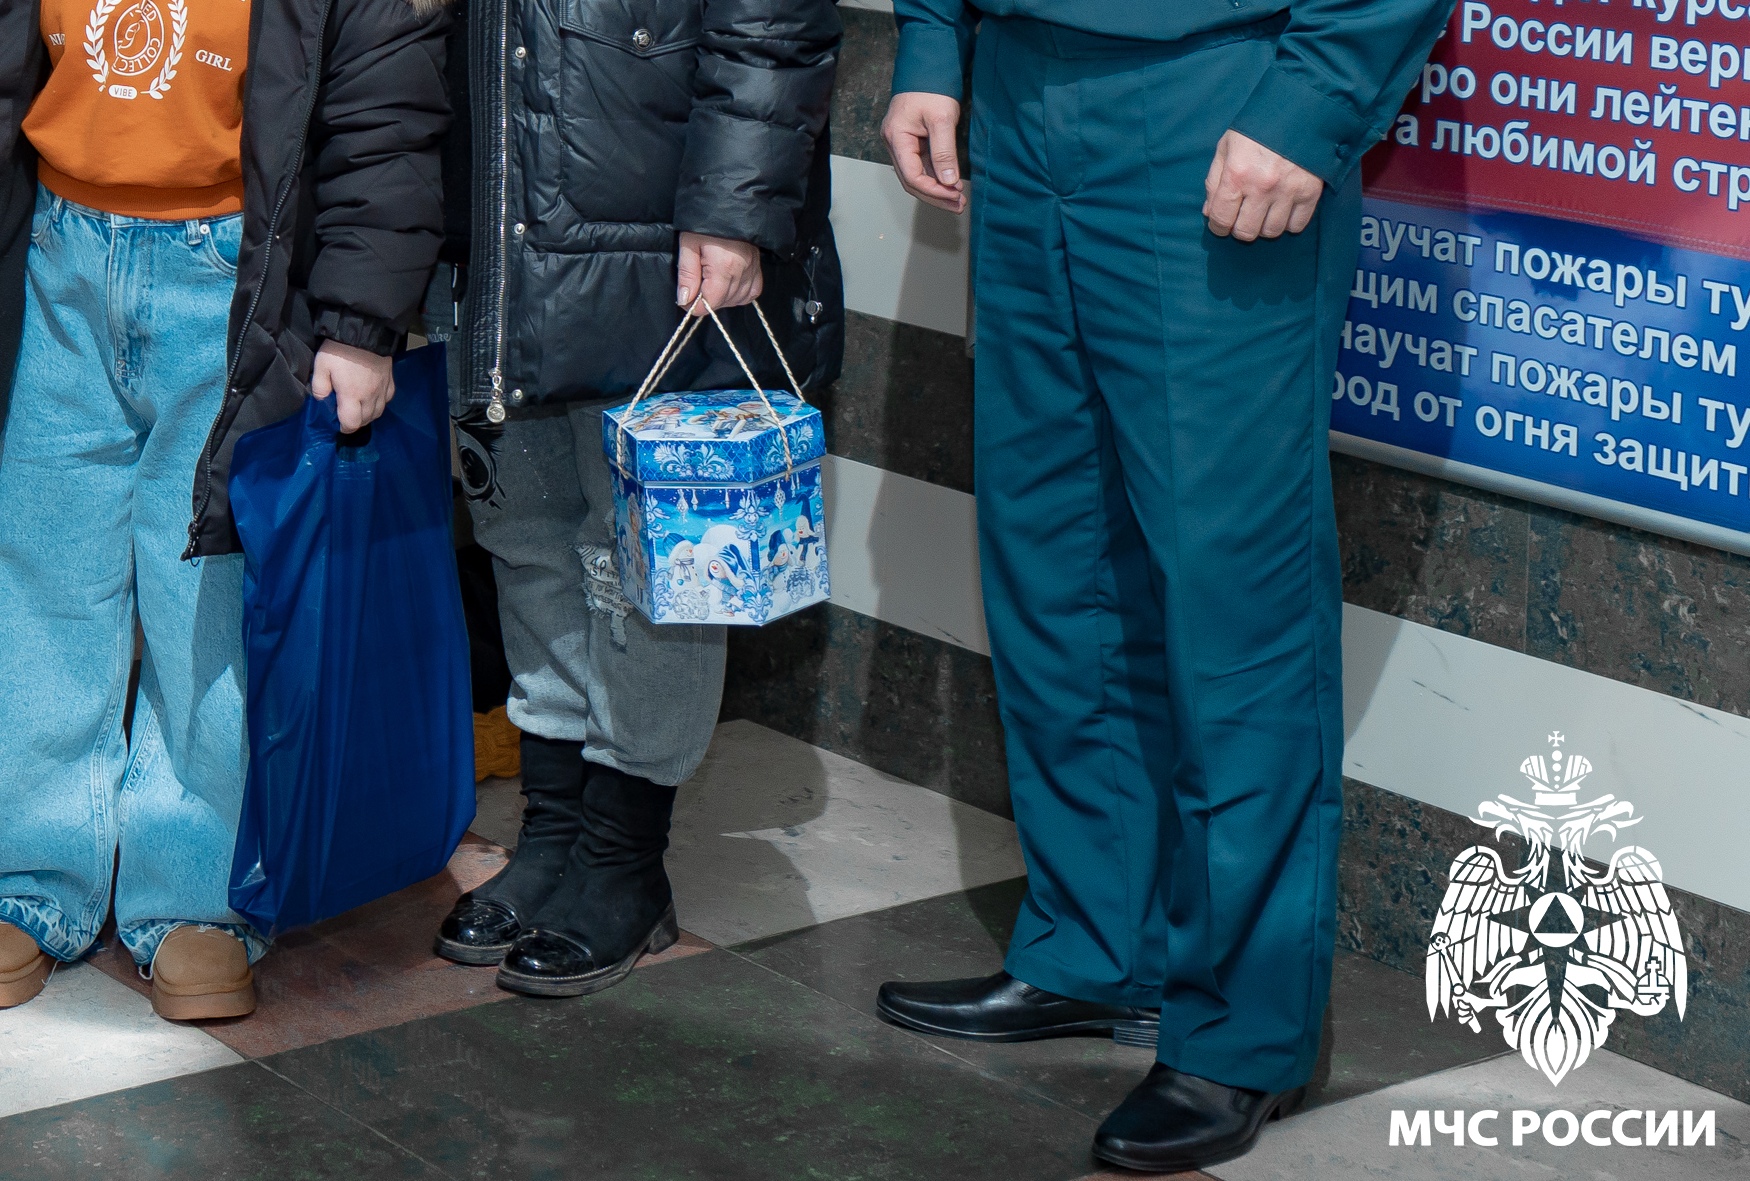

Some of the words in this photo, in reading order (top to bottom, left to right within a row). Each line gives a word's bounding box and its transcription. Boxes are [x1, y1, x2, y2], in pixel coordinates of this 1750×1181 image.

[195, 49, 232, 71] GIRL
[1461, 2, 1632, 63] России
[114, 87, 133, 97] VIBE
[1492, 73, 1575, 113] они
[1432, 121, 1655, 184] любимой
[1496, 242, 1686, 307] пожары
[1454, 291, 1736, 376] спасателем
[1492, 353, 1682, 423] пожары
[1414, 392, 1462, 427] от
[1476, 406, 1577, 456] огня
[1594, 433, 1747, 495] защит
